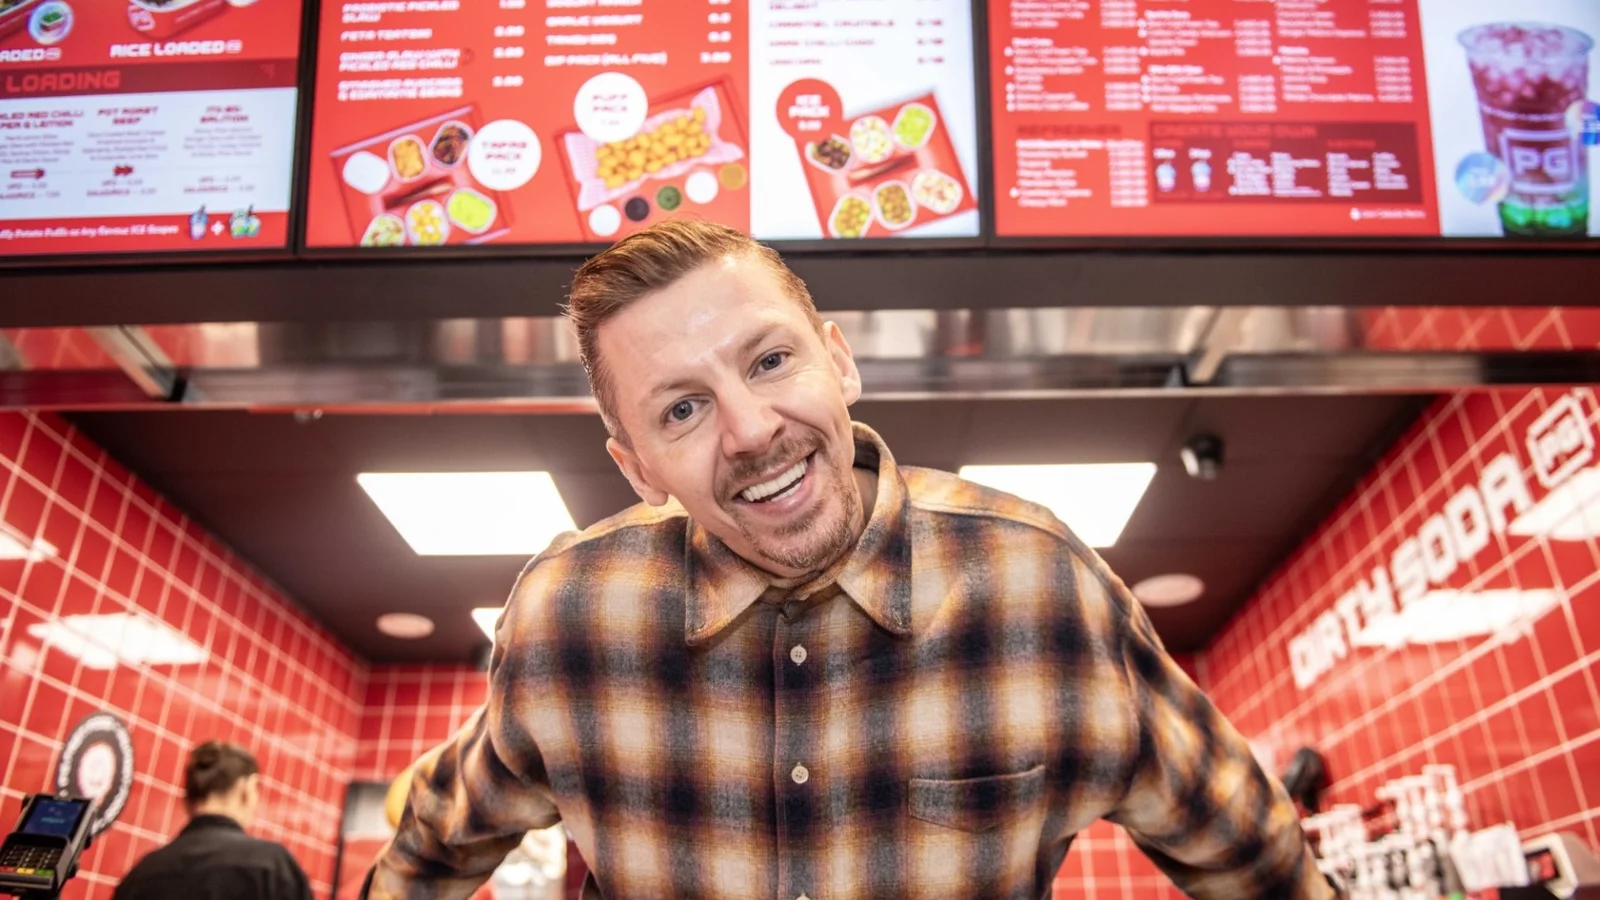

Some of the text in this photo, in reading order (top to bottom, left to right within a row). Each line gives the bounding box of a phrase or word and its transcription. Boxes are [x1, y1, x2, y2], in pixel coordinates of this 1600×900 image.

[110, 43, 152, 58] RICE
[153, 40, 225, 56] LOADED
[6, 70, 120, 93] LOADING
[1510, 146, 1571, 178] PG
[1288, 452, 1532, 690] DIRTY SODA
